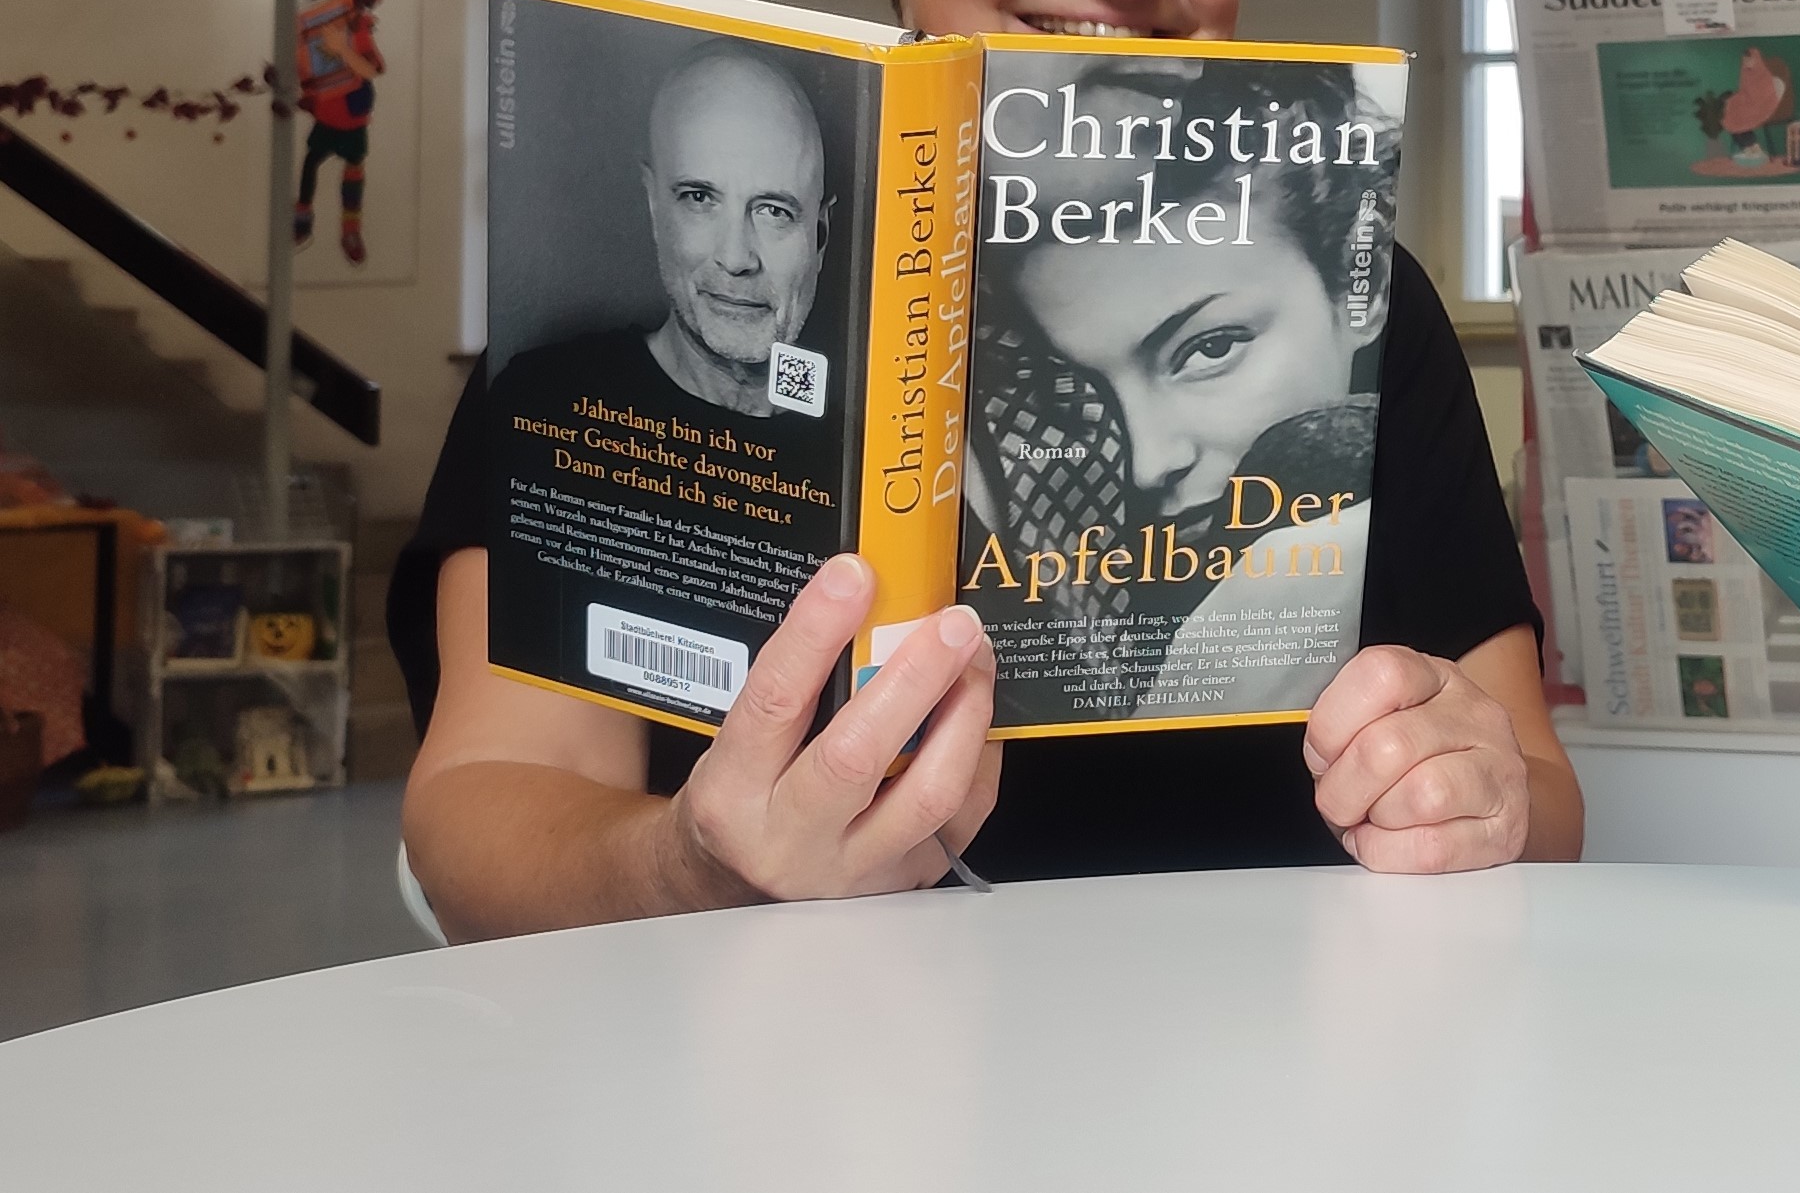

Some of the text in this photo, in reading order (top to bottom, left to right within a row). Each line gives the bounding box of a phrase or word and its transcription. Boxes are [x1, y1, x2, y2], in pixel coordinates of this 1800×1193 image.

[496, 38, 516, 149] ullstein
[983, 83, 1380, 166] Christian
[984, 172, 1256, 246] Berkel
[1346, 225, 1374, 328] ullstein
[1570, 272, 1656, 311] MAIN
[884, 125, 940, 514] Christian Berkel
[932, 119, 976, 508] Der Apfelbaum
[513, 416, 836, 508] meiner Geschichte davongelaufen.
[672, 417, 702, 444] bin
[709, 429, 737, 452] ich
[743, 441, 777, 461] vor
[1018, 443, 1087, 461] Roman
[554, 448, 606, 479] Dann
[612, 467, 673, 496] erfand
[678, 480, 707, 505] ich
[713, 492, 739, 512] sie
[1224, 475, 1354, 531] Der
[510, 477, 805, 562] Für den Roman seiner Familie hat der Schauspieler Christian
[511, 498, 772, 573] seinen Wurzeln nachgespürt. Er hat Archive besucht,
[511, 512, 545, 529] gelesen
[546, 522, 565, 535] und
[566, 525, 598, 543] Reisen
[599, 537, 669, 561] unternommen.
[671, 552, 727, 577] Entstanden
[729, 566, 740, 580] ist
[741, 573, 756, 584] ein
[757, 576, 789, 593] großer
[511, 530, 543, 545] roman
[545, 537, 562, 550] vor
[564, 541, 587, 557] dem
[590, 547, 651, 573] Hintergrund
[654, 566, 680, 580] eines
[682, 574, 717, 591] ganzen
[720, 581, 786, 609] Jahrhunderts
[537, 550, 594, 576] Geschichte,
[596, 565, 612, 579] die
[614, 569, 664, 595] Erzählung
[666, 585, 691, 600] einer
[694, 592, 776, 623] ungewöhnlichen
[961, 522, 1345, 603] Apfelbaum
[620, 621, 715, 655] Stadtbücherei Kitzingen
[1002, 606, 1341, 632] wieder einmal jemand fragt, wo es denn bleibt, das lebens-
[1020, 622, 1339, 649] große Epos über deutsche Geschichte, dann ist von jetzt
[1051, 649, 1077, 662] Hier
[1079, 649, 1093, 660] ist
[1112, 644, 1162, 658] Christian
[1165, 642, 1199, 656] Berkel
[1201, 641, 1219, 654] hat
[1222, 644, 1234, 653] es
[1235, 640, 1300, 654] geschrieben.
[1303, 637, 1339, 649] Dieser
[997, 668, 1010, 680] ist
[1013, 666, 1039, 680] kein
[1043, 663, 1118, 678] schreibender
[1197, 658, 1211, 670] Er
[1215, 658, 1228, 669] ist
[1232, 653, 1302, 668] Schriftsteller
[1304, 651, 1337, 664] durch
[1063, 675, 1198, 693] und durch. Und was für
[1073, 689, 1225, 709] DANIEL KEHLMANN
